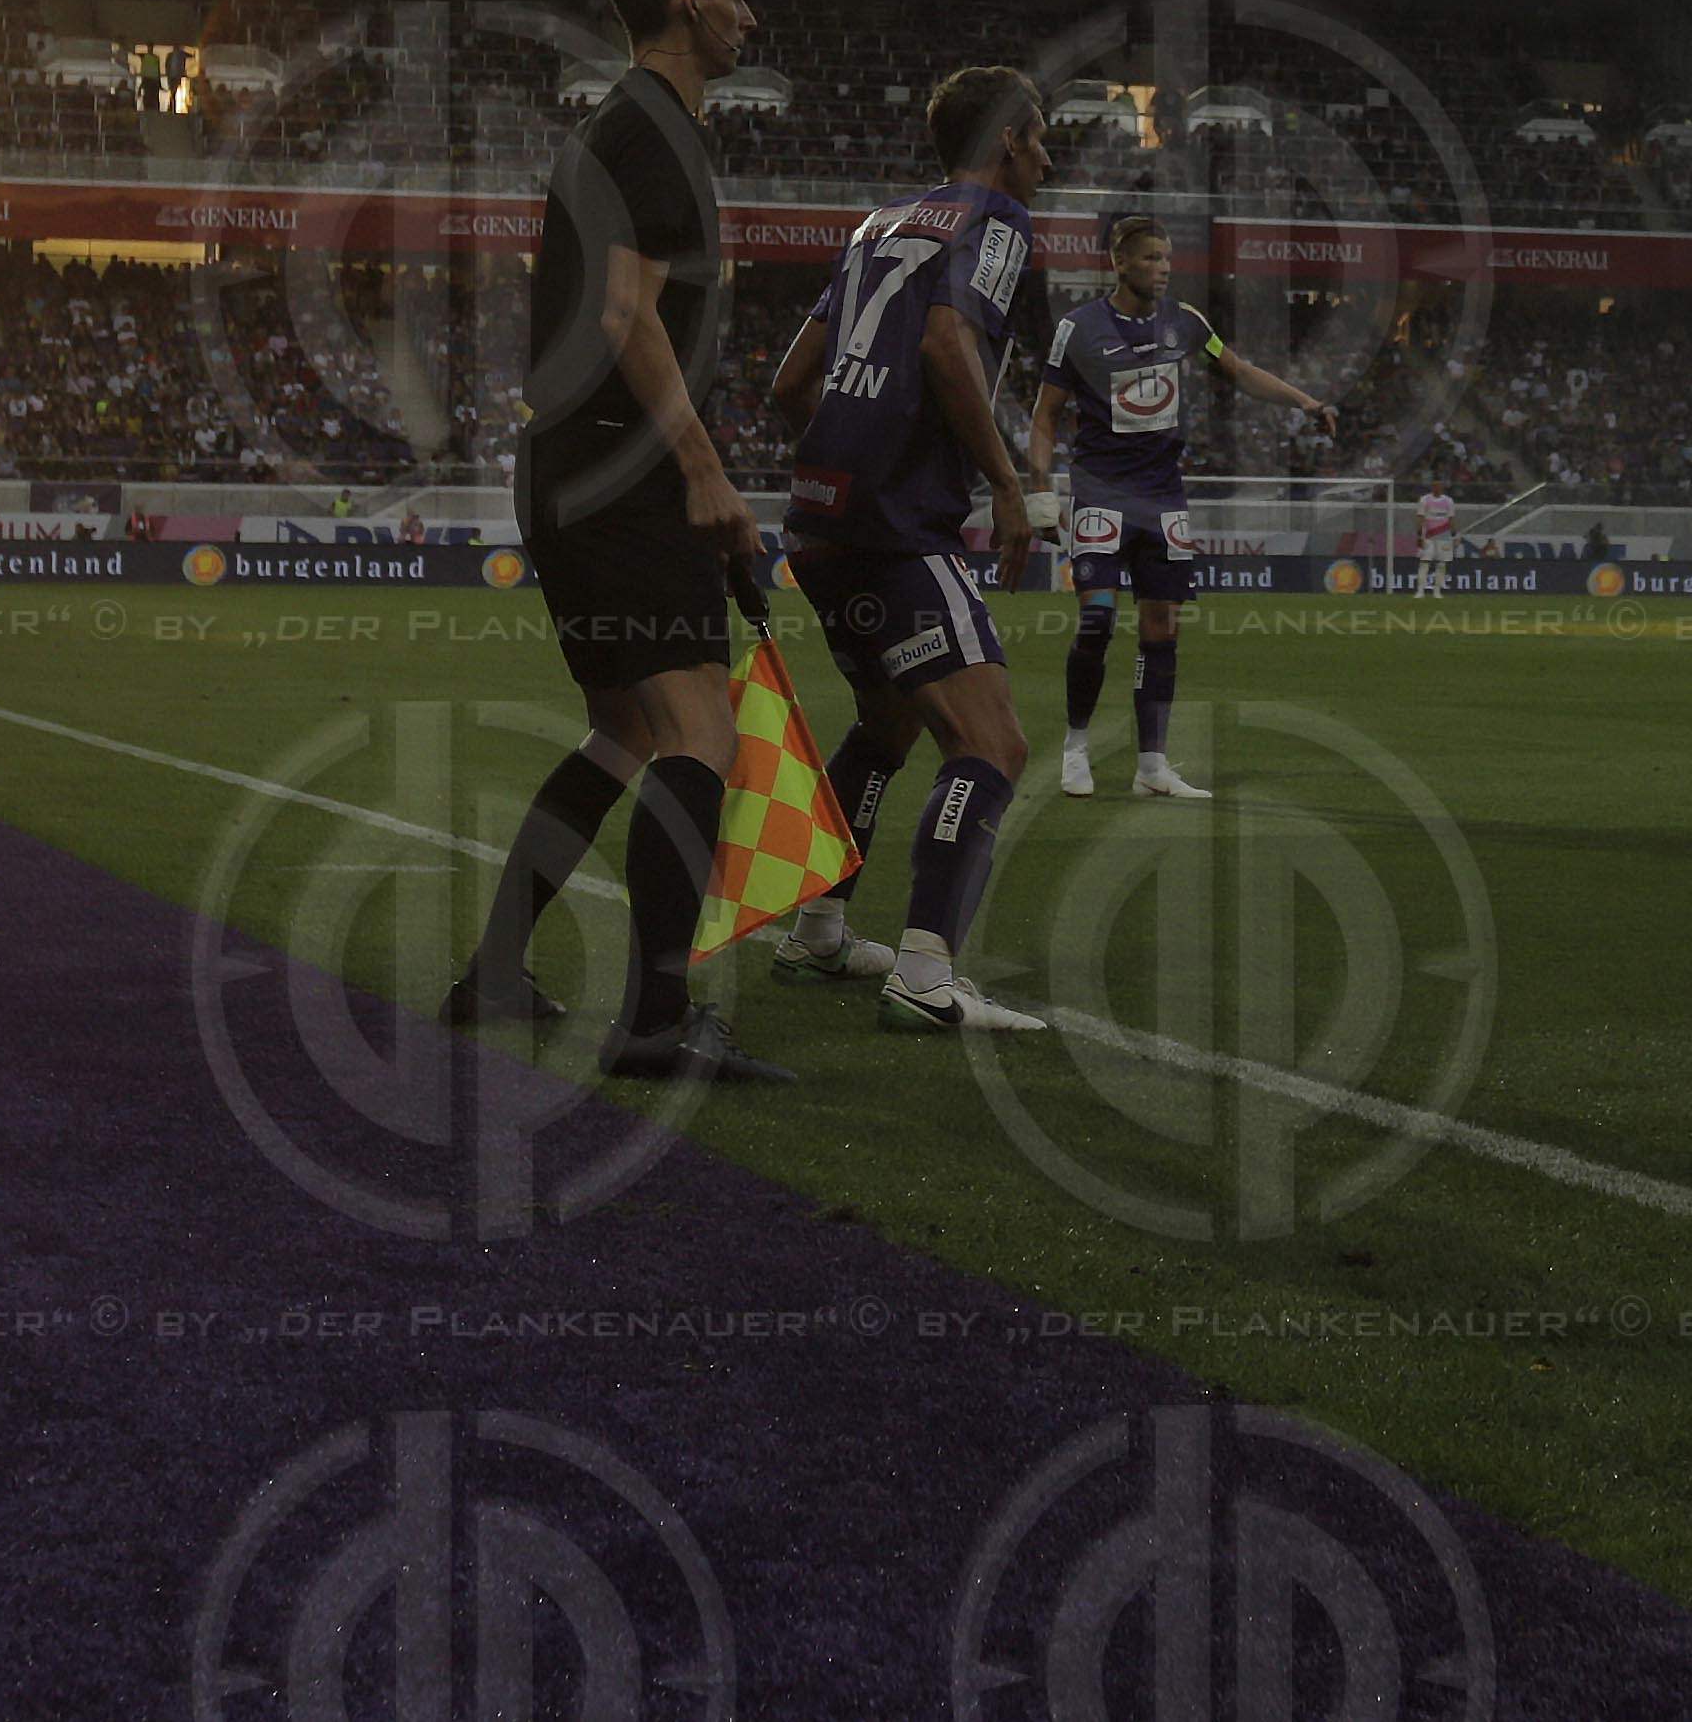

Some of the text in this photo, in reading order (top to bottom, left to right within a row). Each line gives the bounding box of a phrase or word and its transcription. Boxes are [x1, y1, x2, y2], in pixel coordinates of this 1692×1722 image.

[190, 206, 299, 231] GENERALI
[977, 228, 1005, 291] Verbund
[1267, 240, 1364, 263] GENERALI
[1516, 249, 1609, 271] GENERALI
[834, 236, 944, 364] 17
[236, 553, 425, 579] burgenland
